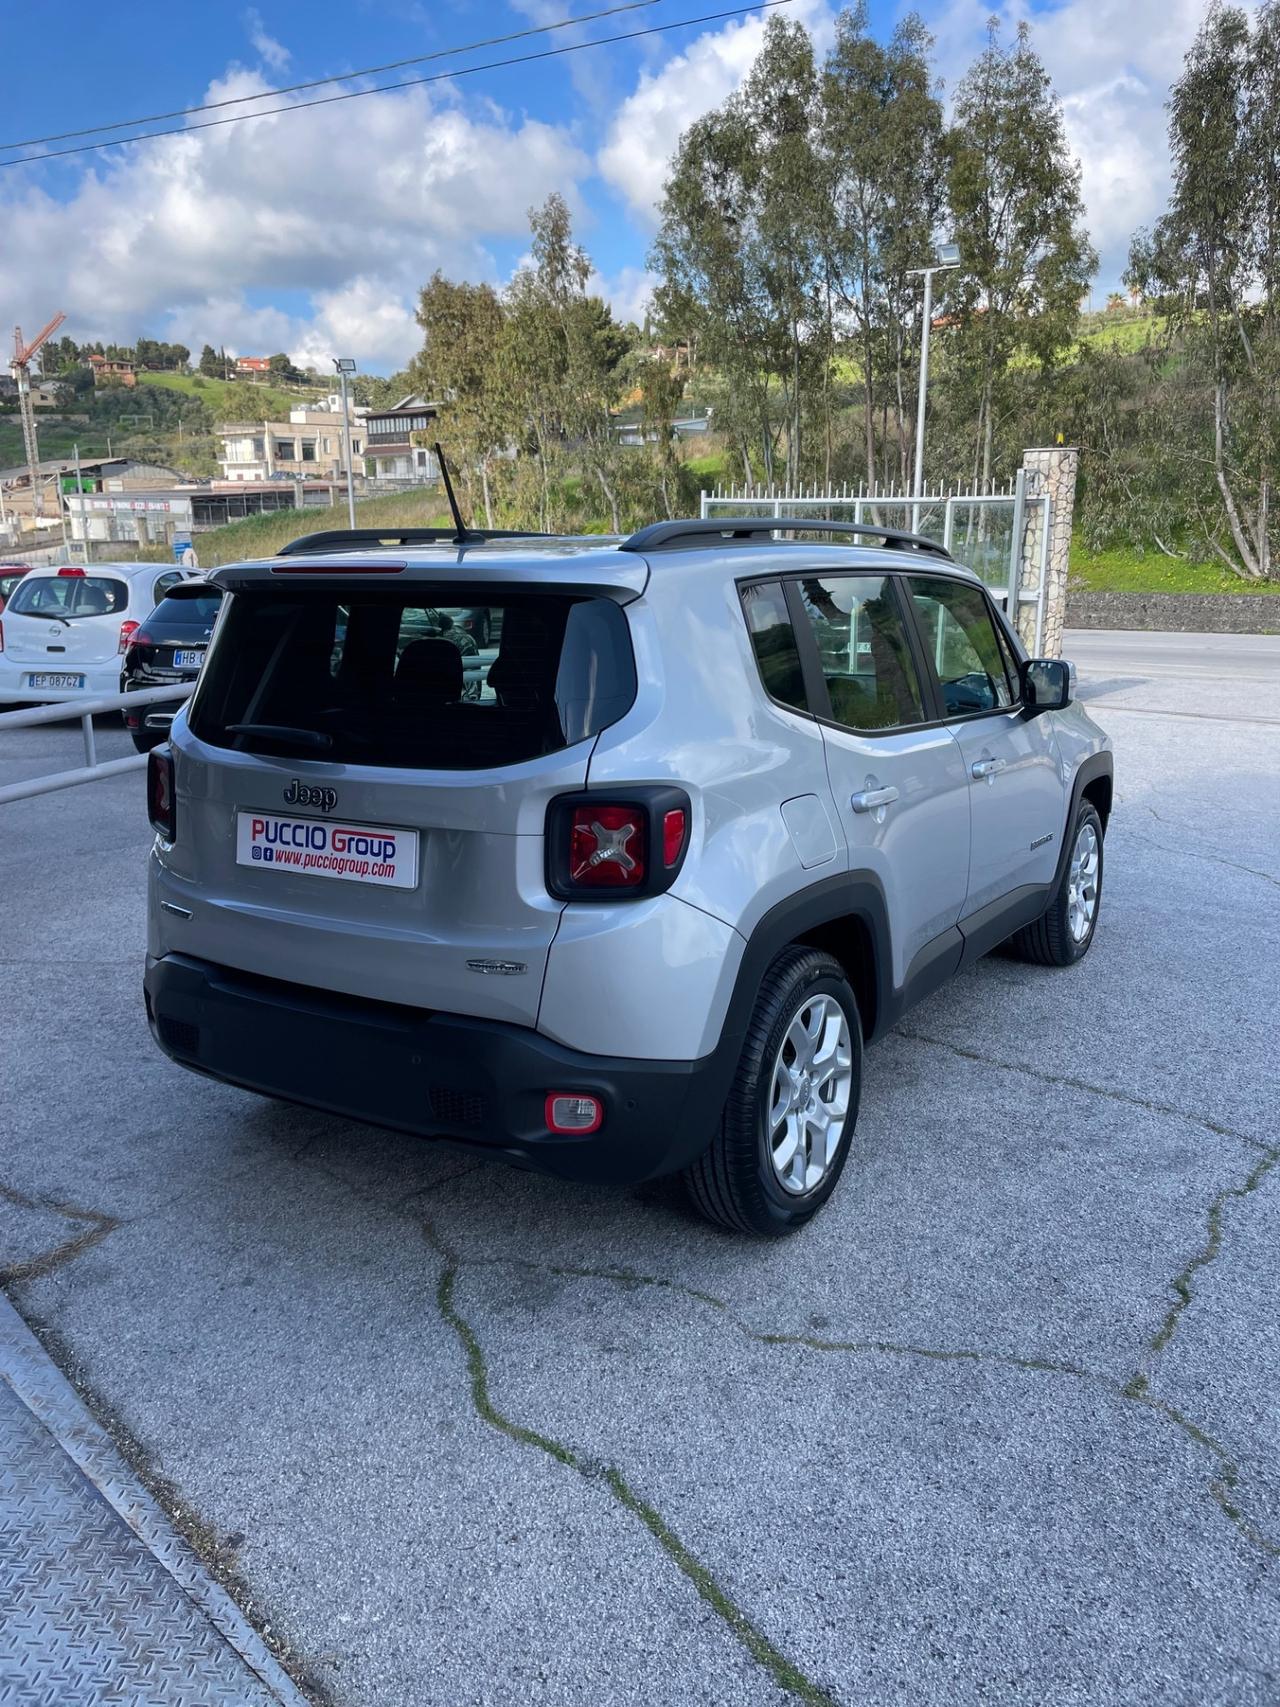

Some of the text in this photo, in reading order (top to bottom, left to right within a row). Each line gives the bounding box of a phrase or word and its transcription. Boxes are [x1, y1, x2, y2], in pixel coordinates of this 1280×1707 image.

[182, 651, 196, 664] HB
[35, 675, 47, 686] EP
[283, 778, 338, 812] Jeep
[251, 818, 327, 851] PUCCIO
[275, 848, 396, 879] www.pucciogroup.com
